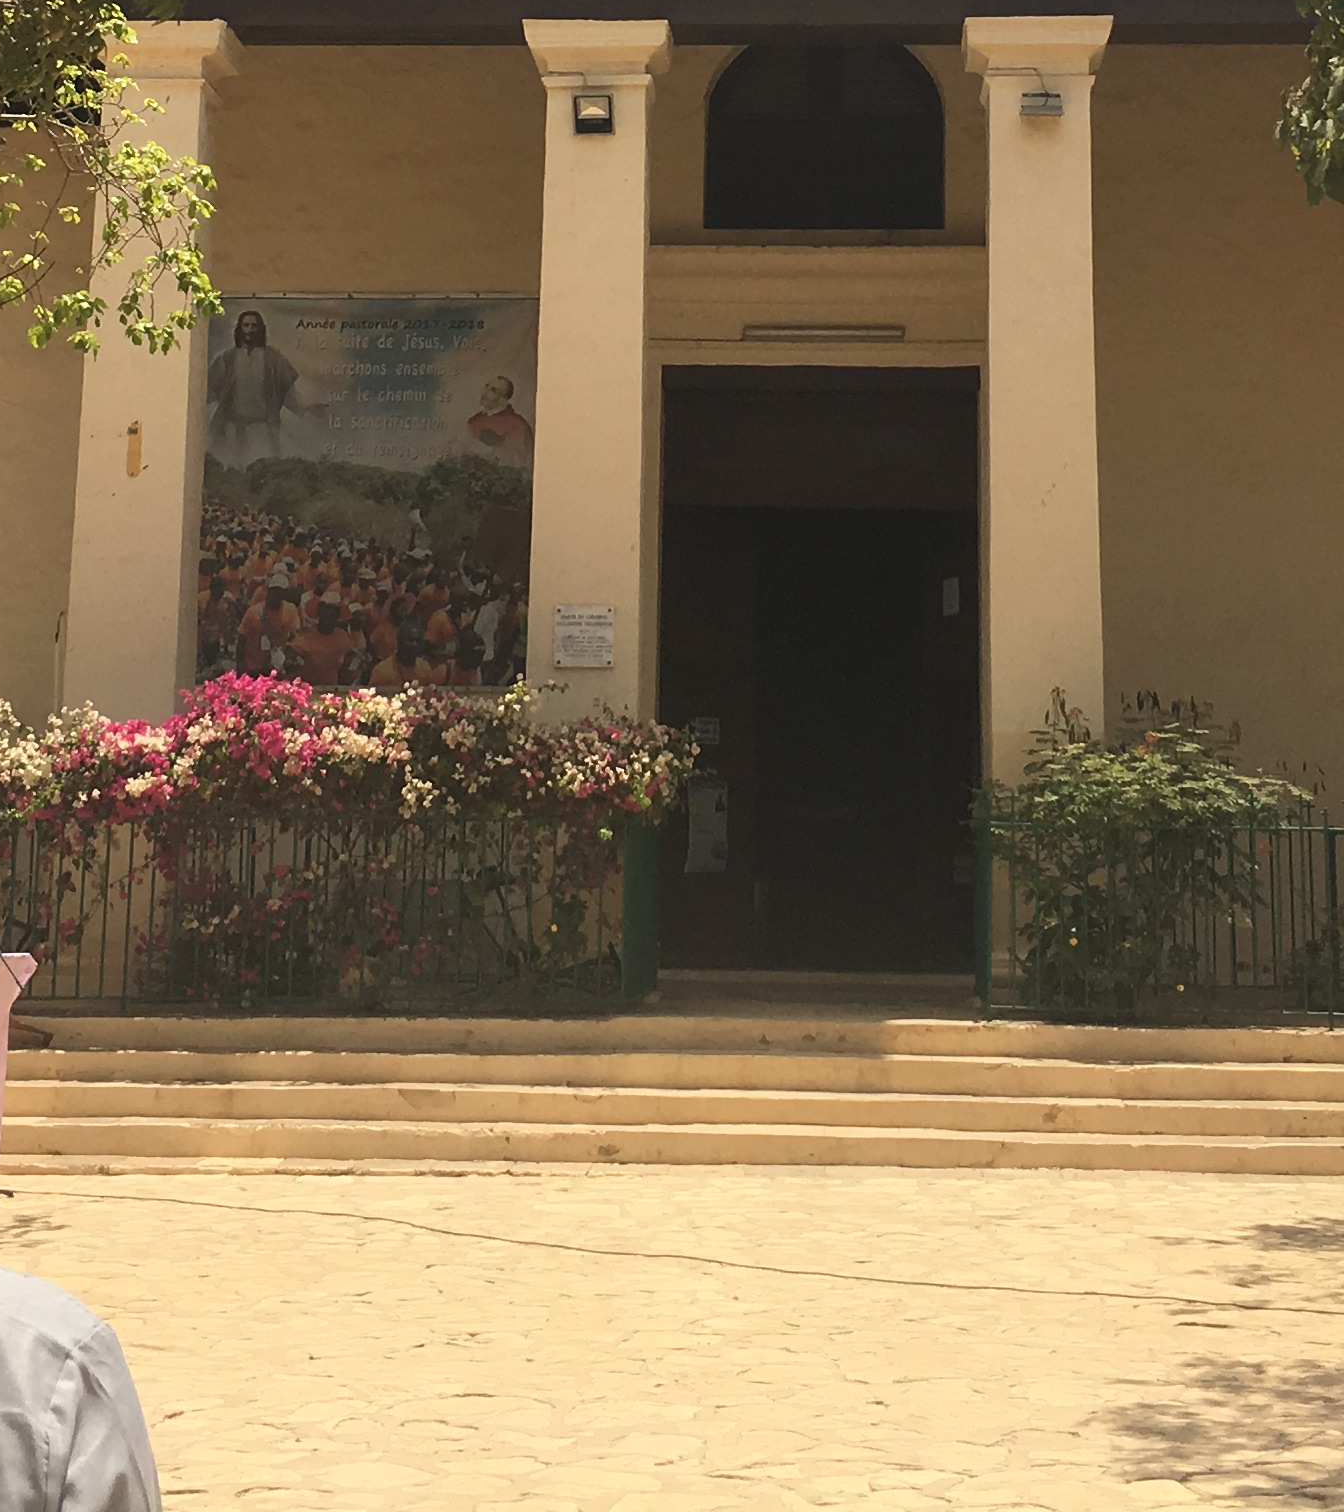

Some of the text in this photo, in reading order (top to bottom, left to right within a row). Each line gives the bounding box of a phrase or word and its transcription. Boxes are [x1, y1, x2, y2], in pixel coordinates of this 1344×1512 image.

[295, 317, 485, 333] Année pastorale 2017-2018
[376, 333, 394, 349] de
[401, 332, 444, 352] Jésus,
[319, 360, 387, 377] marchons
[327, 389, 349, 403] sur
[357, 387, 371, 403] le
[377, 385, 427, 403] chemin
[328, 413, 342, 429] la
